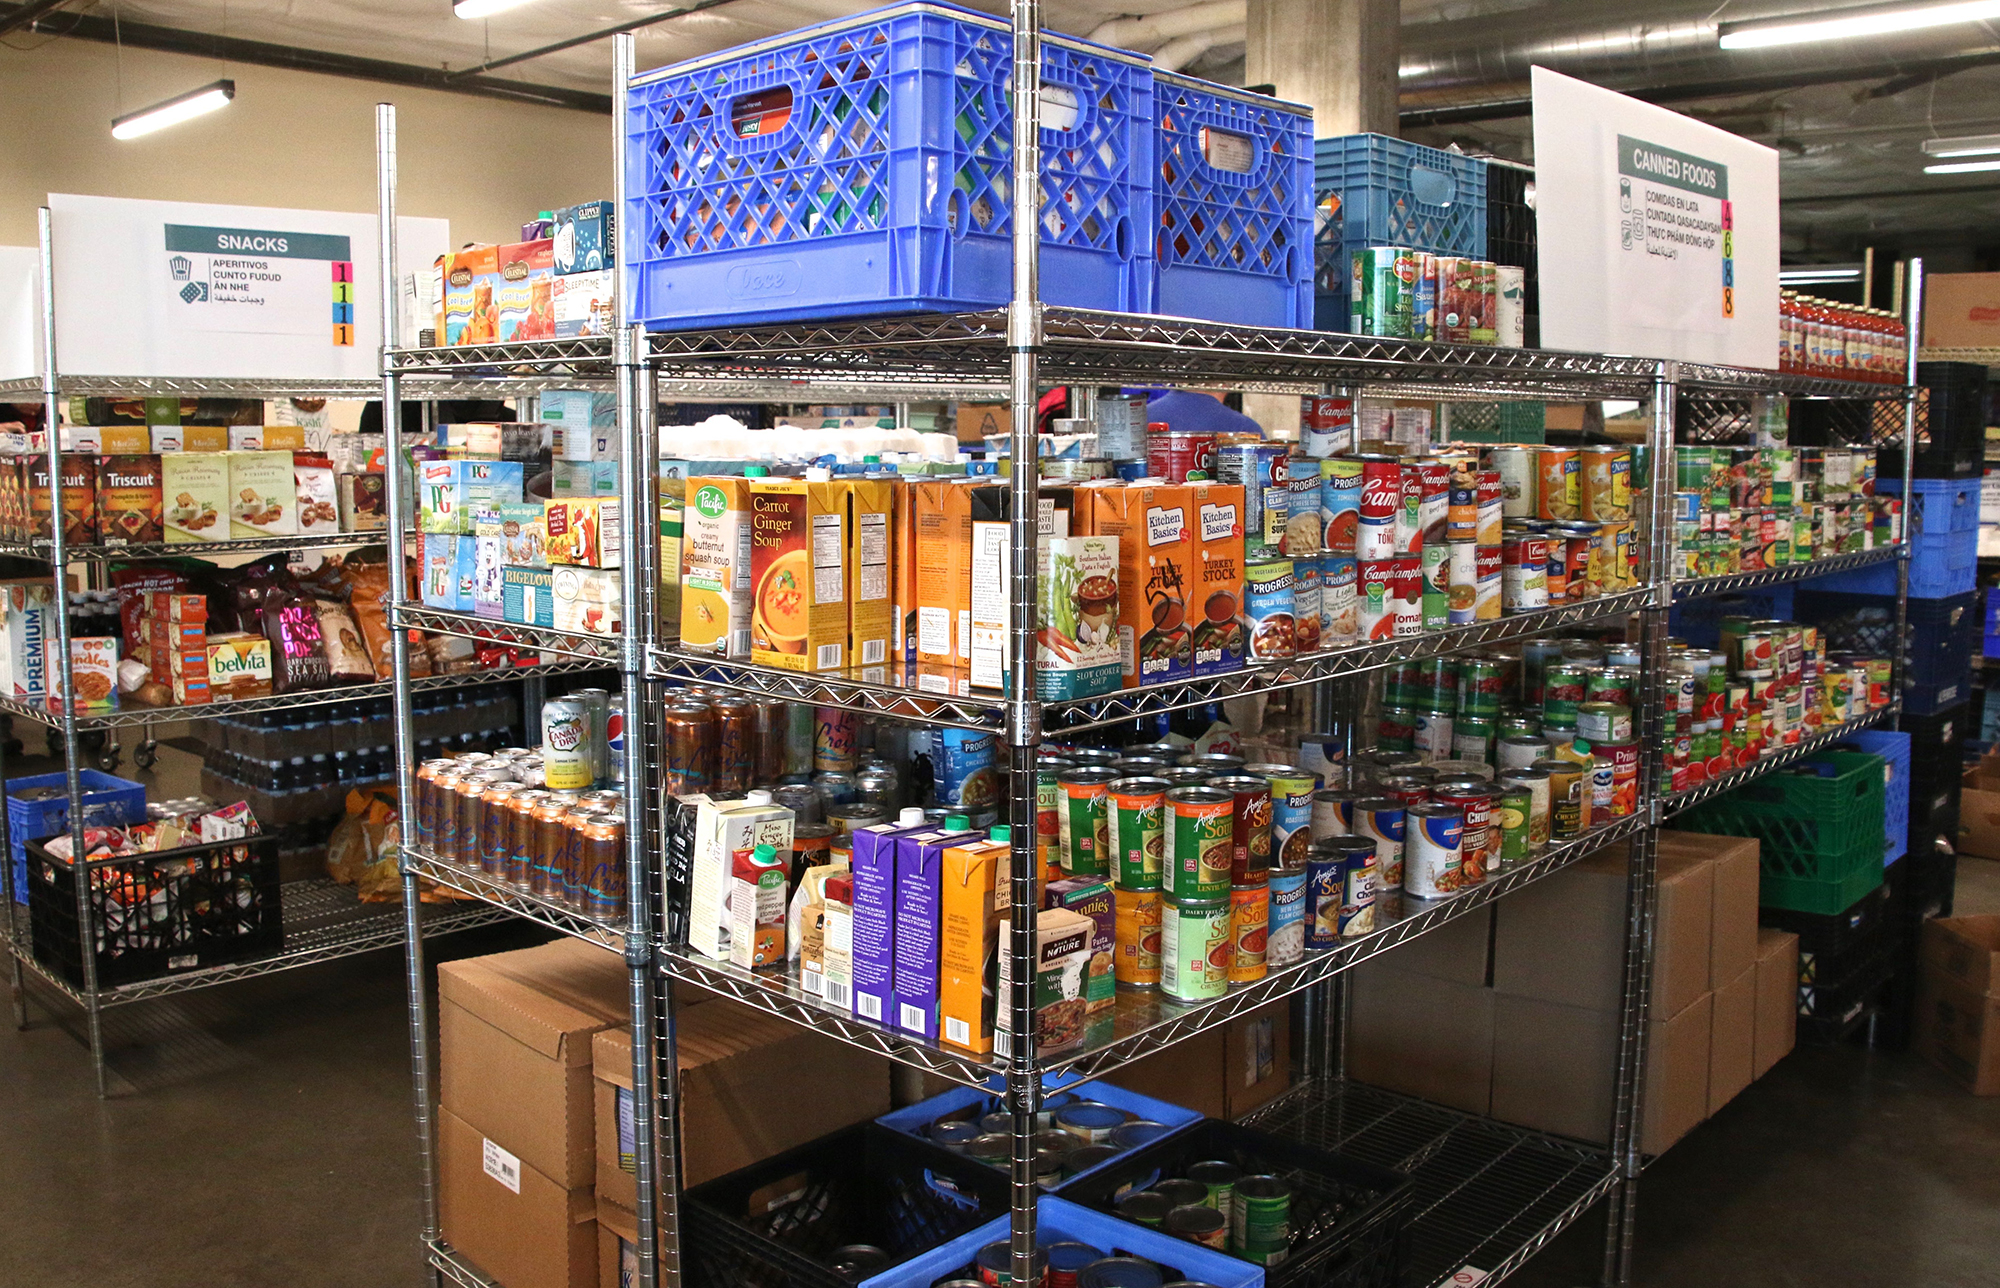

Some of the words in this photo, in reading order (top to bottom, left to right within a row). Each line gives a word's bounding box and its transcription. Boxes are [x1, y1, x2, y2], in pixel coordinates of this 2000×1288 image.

[1633, 147, 1681, 180] CANNED
[1682, 163, 1717, 190] FOODS
[1646, 189, 1676, 209] COMIDAS
[1676, 196, 1685, 211] EN
[1685, 199, 1699, 213] LATA
[1646, 207, 1676, 224] CUNTADA
[1676, 213, 1722, 235] QASACADAYSAN
[217, 234, 289, 252] SNACKS
[1725, 231, 1732, 259] 6
[213, 259, 268, 269] APERITIVOS
[504, 265, 527, 277] CELESTIAL
[213, 271, 247, 280] CUNTO
[249, 273, 282, 282] FUDUD
[338, 263, 347, 282] 1
[1725, 260, 1732, 287] 8
[564, 278, 600, 293] SLEEPYTIME
[339, 284, 348, 303] 1
[501, 293, 514, 302] Cool
[515, 291, 530, 301] Brew
[447, 296, 459, 306] Cool
[460, 297, 473, 305] Brew
[1725, 287, 1732, 315] 8
[340, 305, 348, 324] 1
[340, 326, 348, 345] 1
[296, 416, 322, 428] Kashi
[1327, 437, 1339, 446] Beef
[107, 471, 154, 487] Triscuit
[472, 465, 487, 479] PG
[34, 472, 85, 487] Trcuit
[1289, 474, 1321, 492] PROGRESS
[429, 485, 451, 513] PG
[698, 490, 725, 512] Pacific
[1360, 477, 1397, 511] Camp
[753, 497, 790, 513] Carrot
[1428, 506, 1439, 515] Beef
[754, 514, 792, 534] Ginger
[1149, 514, 1181, 528] Kitchen
[1202, 511, 1233, 524] Kitchen
[702, 522, 720, 531] organic
[1206, 524, 1231, 536] Basics
[700, 532, 719, 541] creamy
[754, 532, 783, 550] Soup
[1153, 528, 1178, 540] Basics
[1378, 533, 1394, 545] TOMA
[692, 538, 725, 553] butternut
[685, 552, 712, 566] squash
[713, 556, 730, 568] soup
[1204, 559, 1234, 570] TURKEY
[430, 567, 446, 597] PG
[505, 569, 552, 588] BIGELOW
[1203, 568, 1236, 582] STOCK
[143, 579, 158, 587] HOT
[1336, 585, 1355, 598] Light
[1251, 599, 1275, 608] GARDEN
[1398, 626, 1421, 634] SOUP
[25, 608, 44, 692] PREMIUM
[215, 652, 266, 674] belVita
[1037, 661, 1059, 669] TURAL
[287, 665, 308, 676] SEA
[1076, 671, 1094, 682] SLOW
[1095, 666, 1120, 677] COOKER
[1090, 677, 1107, 687] SOUP
[549, 725, 584, 743] CANADA
[558, 735, 578, 747] DRY
[1243, 792, 1268, 820] Amy's
[1193, 805, 1222, 833] Amy's
[763, 823, 781, 832] Miso
[760, 832, 783, 844] Ginger
[1463, 834, 1484, 844] ROASTED
[762, 875, 780, 886] Pacific
[1244, 871, 1265, 880] HEARTY
[1311, 865, 1337, 888] Amy's
[1067, 891, 1089, 903] CERTIFIED
[1089, 886, 1107, 897] ORGANIC
[1197, 884, 1219, 892] LENTIL
[1276, 882, 1306, 904] PROGRESS
[763, 909, 781, 917] tomato
[764, 901, 784, 912] pepper
[1232, 894, 1258, 919] Amy's
[1280, 905, 1291, 913] NEW
[1242, 907, 1268, 925] SOU
[1278, 911, 1292, 921] CLAM
[1047, 940, 1080, 957] NATURE
[1092, 936, 1109, 947] Pasta
[1102, 942, 1113, 952] Soup
